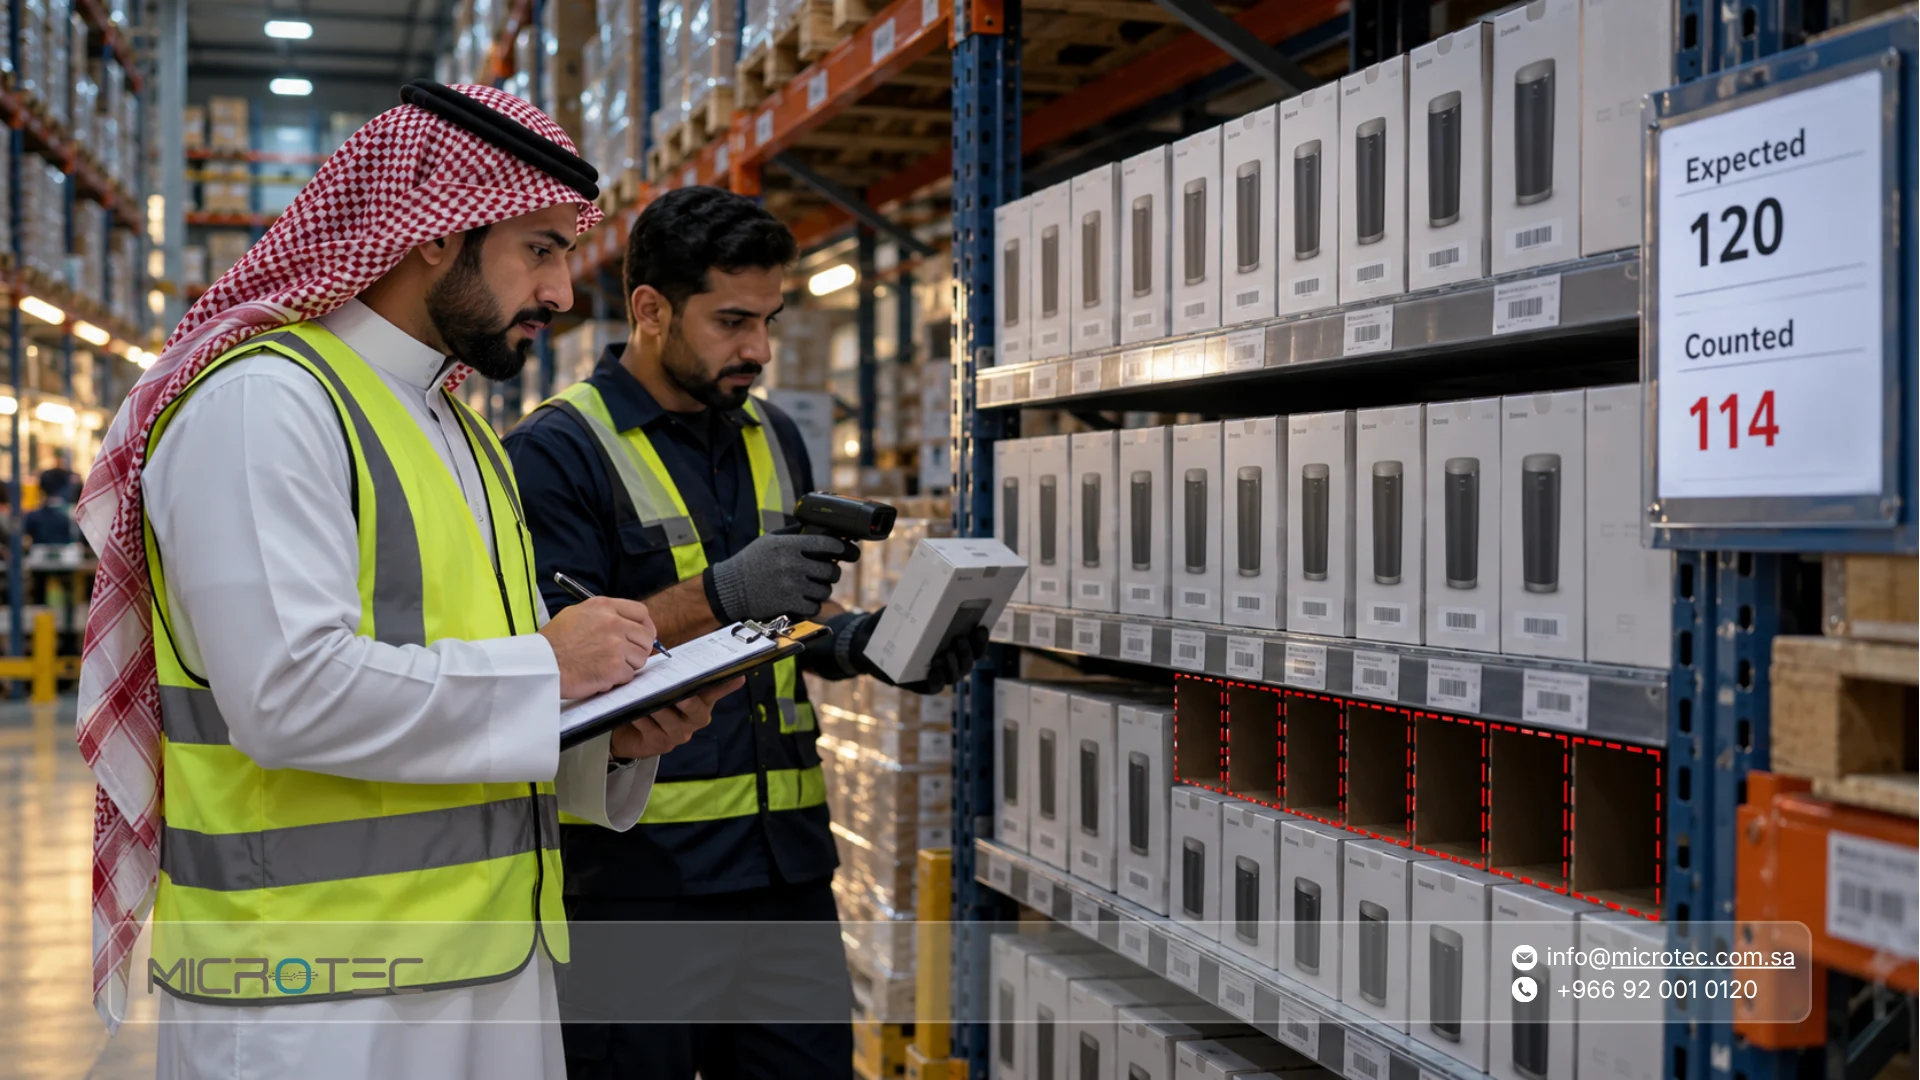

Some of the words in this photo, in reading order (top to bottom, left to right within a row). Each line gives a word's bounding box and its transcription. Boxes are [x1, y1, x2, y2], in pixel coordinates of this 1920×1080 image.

[1686, 128, 1806, 183] Expected
[1689, 196, 1784, 268] 120
[1685, 319, 1794, 360] Counted
[1689, 390, 1780, 451] 114
